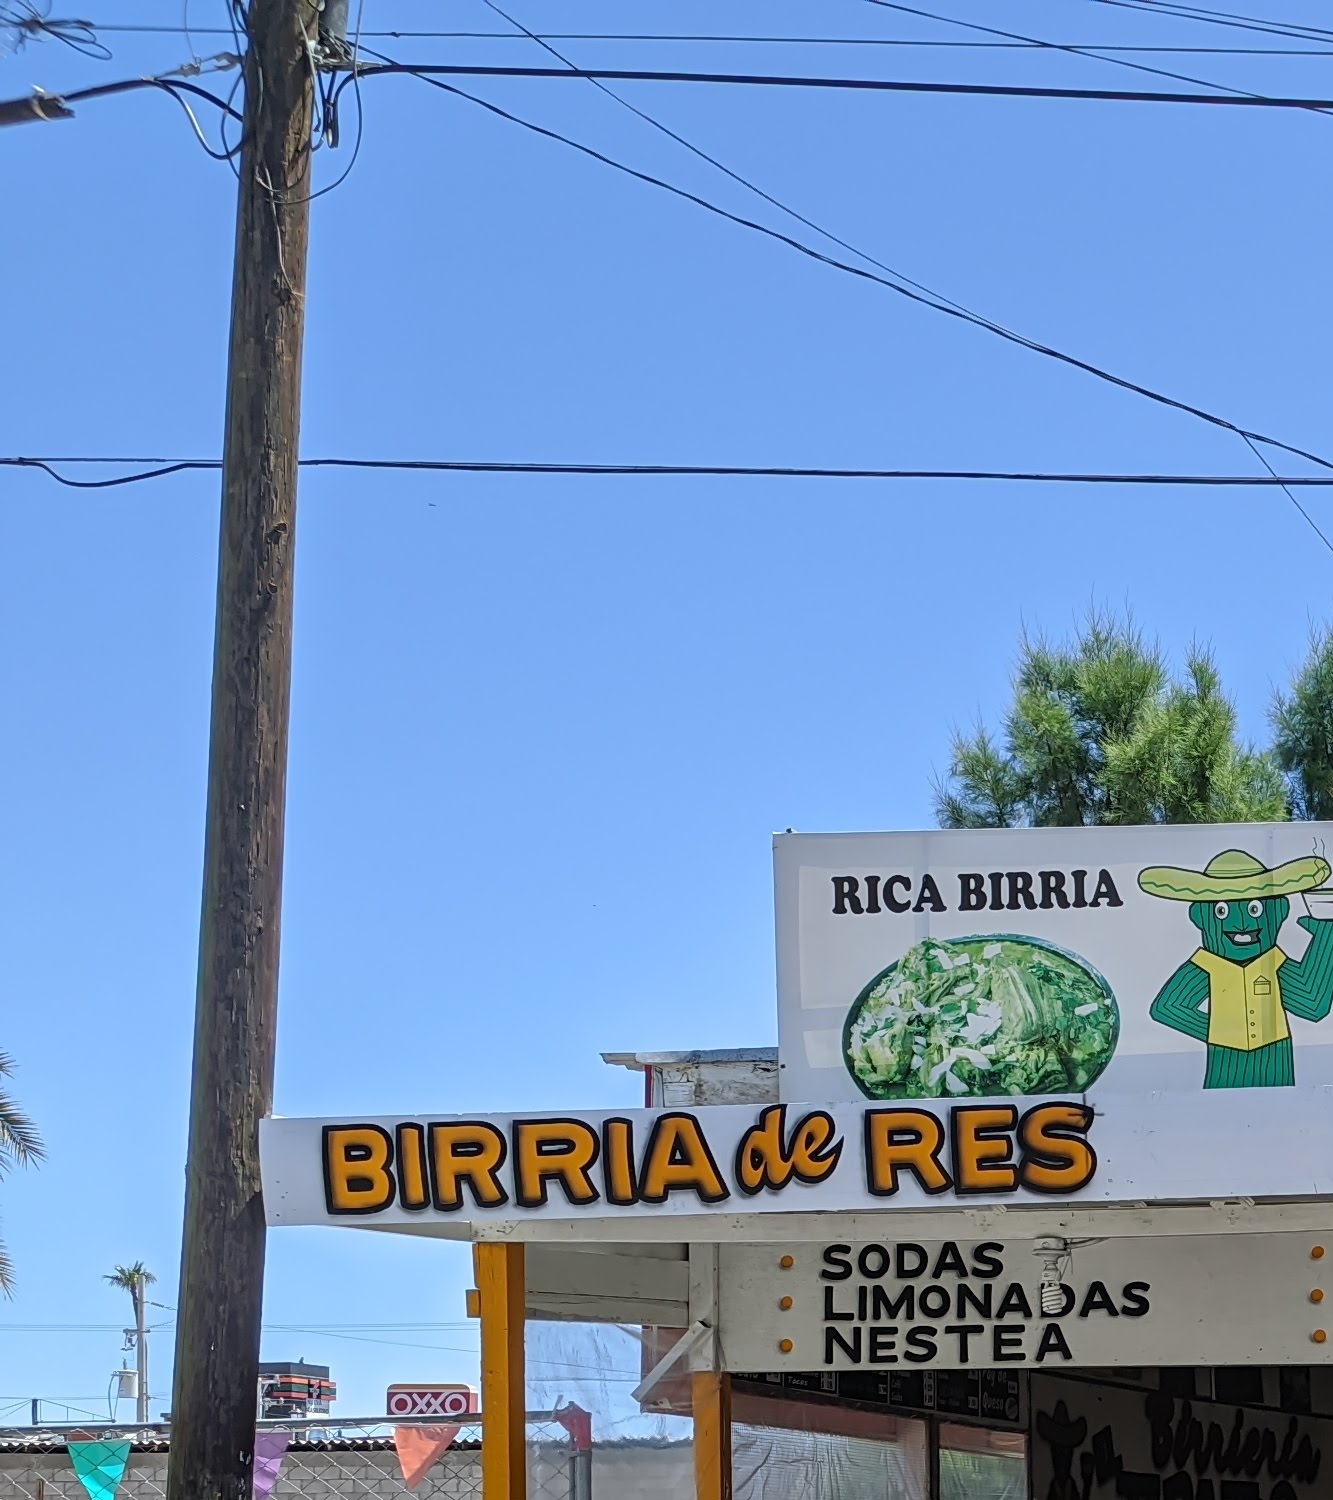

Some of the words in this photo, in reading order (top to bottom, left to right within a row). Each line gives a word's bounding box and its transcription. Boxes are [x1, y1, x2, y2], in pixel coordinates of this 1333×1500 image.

[832, 872, 947, 915] RICA
[959, 869, 1123, 912] BIRRIA
[322, 1112, 730, 1215] BIRRIA
[736, 1102, 846, 1196] de
[865, 1101, 1096, 1198] RES
[820, 1242, 1005, 1281] SODAS
[823, 1281, 1149, 1322] LIMONADAS
[824, 1323, 1072, 1365] NESTEA
[390, 1392, 467, 1414] OXXO
